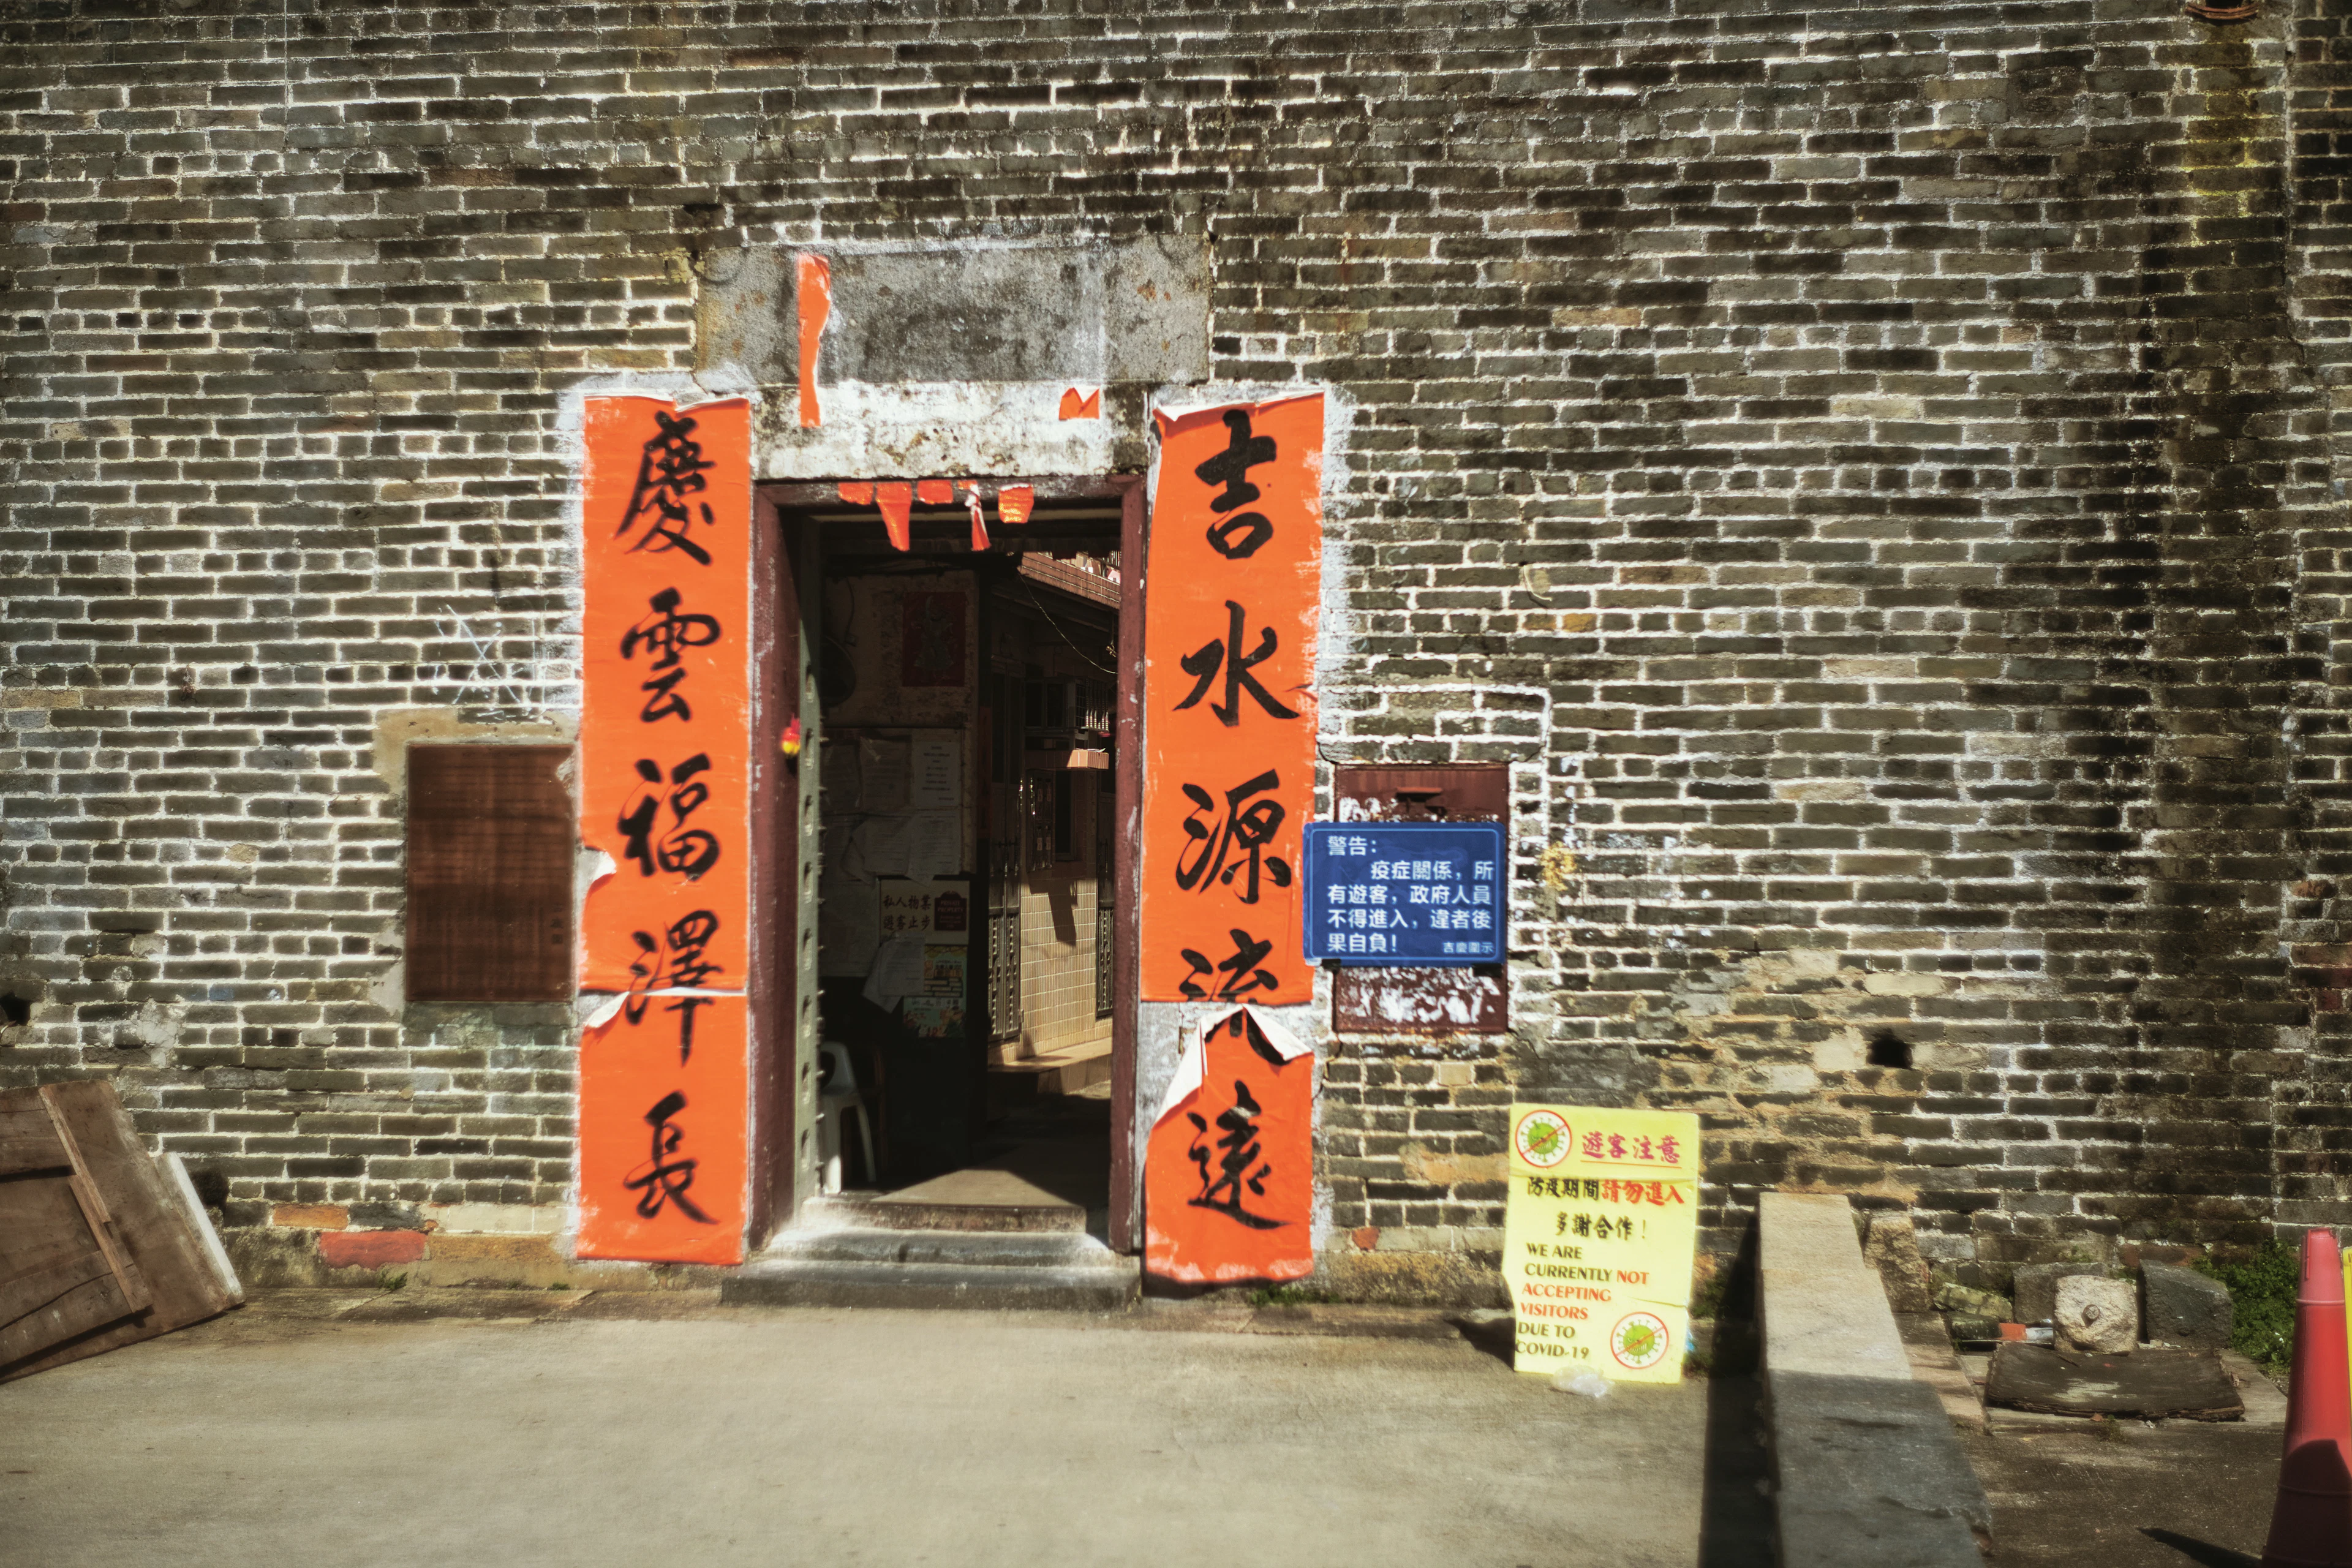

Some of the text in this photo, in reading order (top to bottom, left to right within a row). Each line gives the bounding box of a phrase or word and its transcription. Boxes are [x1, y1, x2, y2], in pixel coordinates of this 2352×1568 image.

[1581, 1130, 1680, 1164] 遊客注意
[1526, 1242, 1583, 1259] WE ARE
[1524, 1262, 1650, 1285] CURRENTLY NOT
[1521, 1283, 1611, 1302] ACCEPTING
[1520, 1302, 1589, 1320] VISITORS
[1518, 1321, 1575, 1338] DUE TO
[1516, 1340, 1590, 1359] COVID-19
